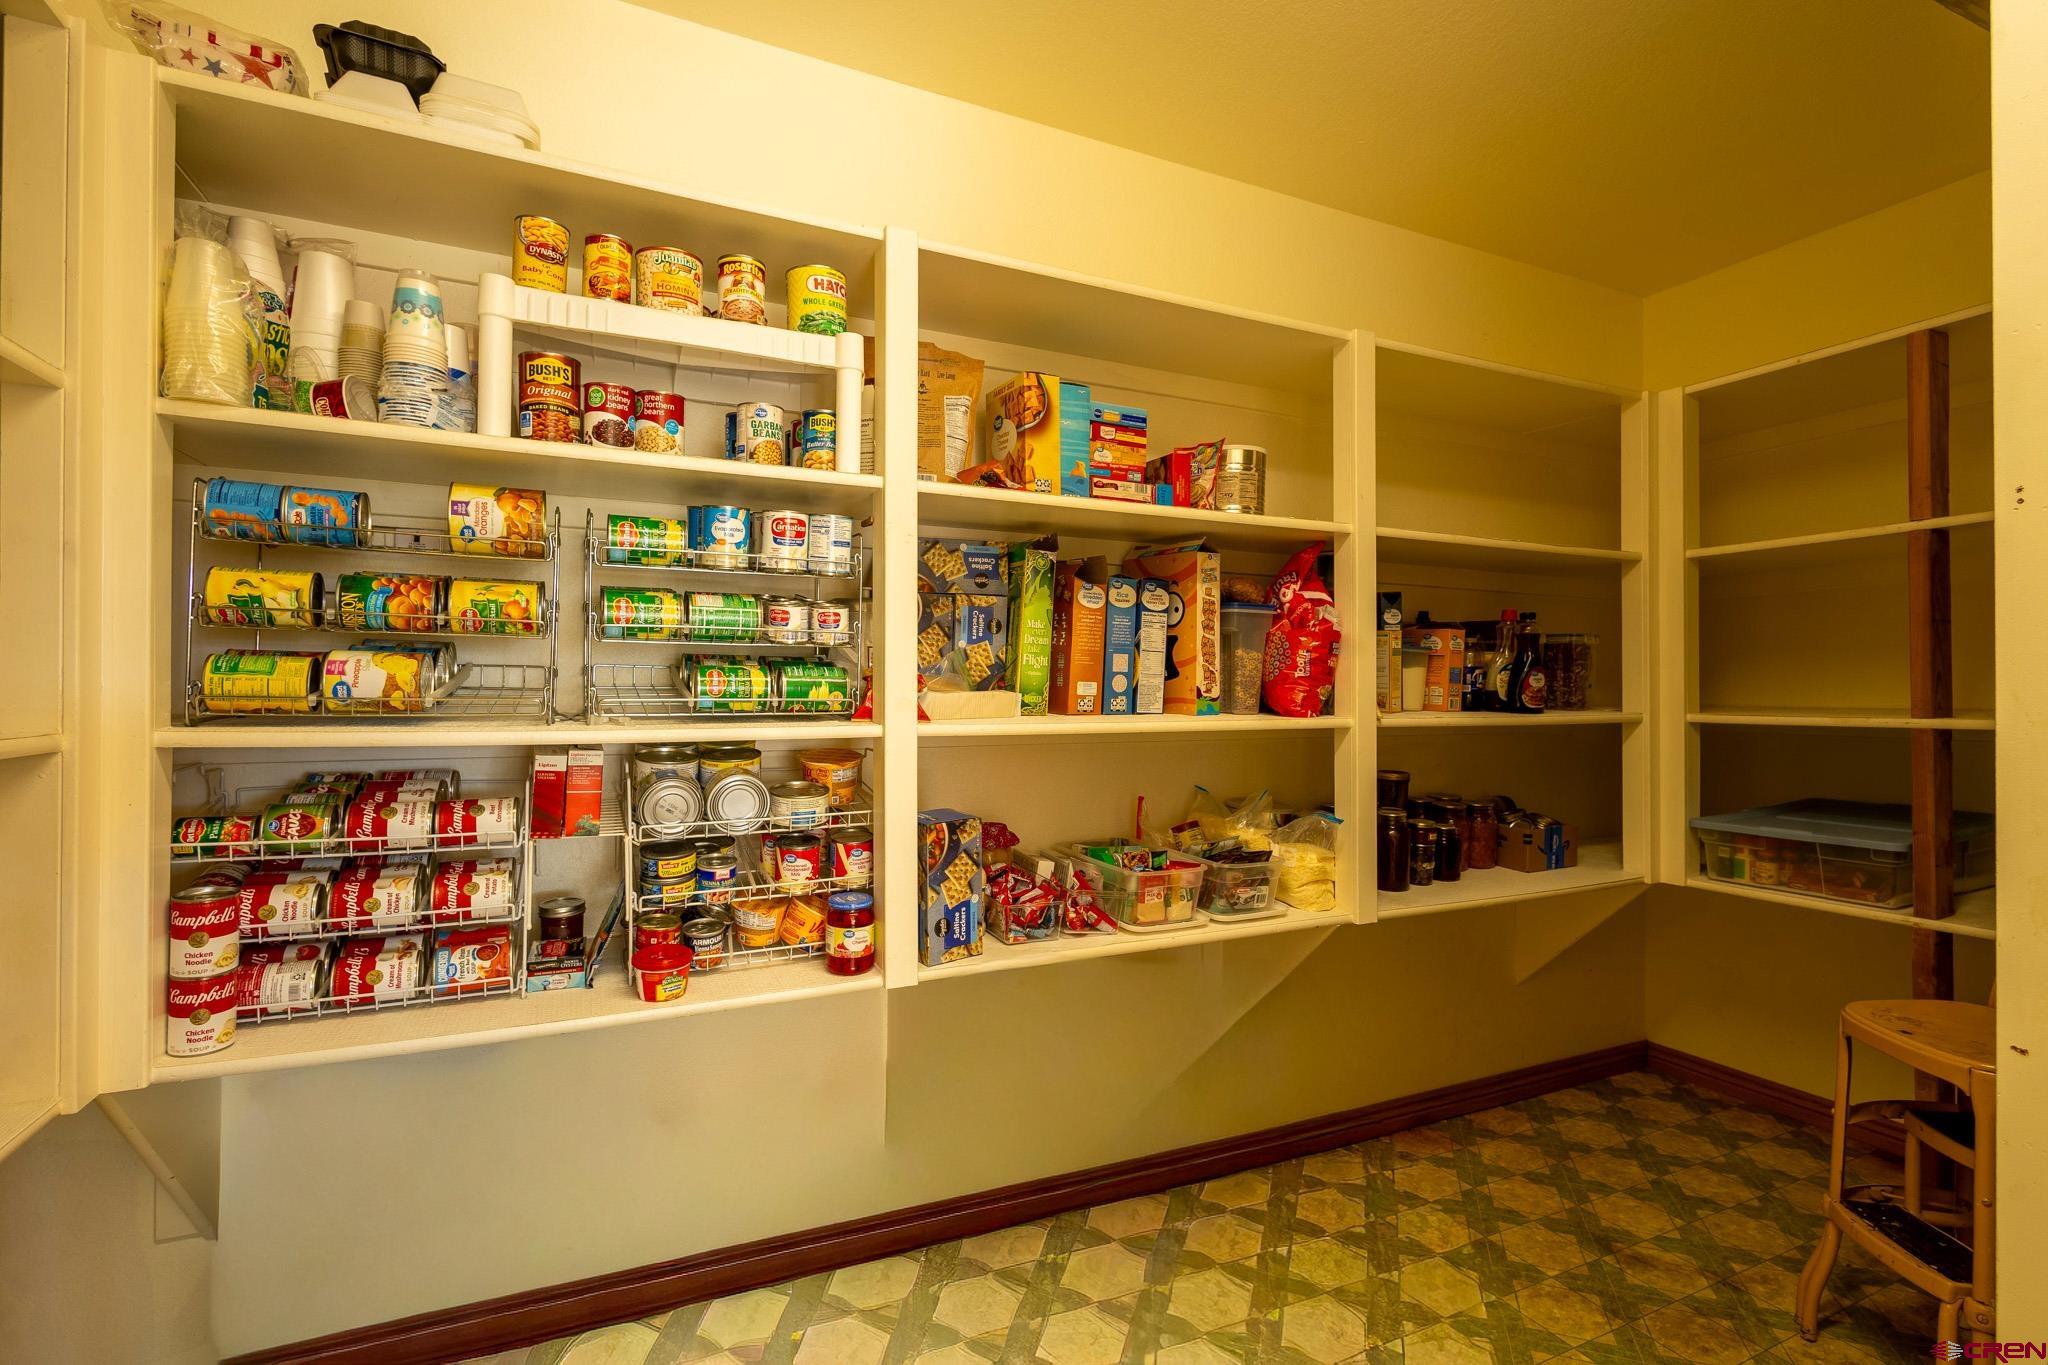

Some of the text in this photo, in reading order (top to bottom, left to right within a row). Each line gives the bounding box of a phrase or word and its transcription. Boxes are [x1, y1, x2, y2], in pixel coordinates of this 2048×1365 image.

[529, 245, 564, 262] DYNASTY
[653, 251, 697, 270] Juanita's
[522, 265, 564, 282] Baby Corn
[656, 283, 695, 297] HOMINY
[813, 277, 847, 298] HATC
[803, 298, 845, 311] WHOLE GREEN
[528, 363, 570, 382] BUSH'S
[527, 385, 572, 400] Original
[644, 395, 663, 403] great
[606, 401, 629, 411] beans
[607, 393, 631, 406] kidney
[644, 401, 675, 411] northern
[550, 406, 570, 415] BEANS
[644, 408, 665, 416] beans
[751, 420, 784, 431] GARBAN
[810, 417, 836, 428] BUSH'
[752, 429, 782, 440] BEANS
[480, 502, 490, 536] Oranges
[772, 521, 805, 533] Carnation
[356, 600, 366, 625] PRDE
[1026, 620, 1045, 629] Make
[1024, 635, 1049, 644] Dream
[1028, 645, 1040, 653] take
[1023, 653, 1048, 669] Flight
[352, 658, 362, 688] Pineapple
[408, 802, 417, 826] Mushroom
[209, 820, 221, 839] Paste
[280, 817, 288, 835] TOMATO
[288, 808, 302, 841] SAUCE
[490, 878, 498, 895] Potato
[387, 892, 393, 900] of
[393, 892, 401, 914] Chicken
[282, 900, 290, 922] Chicken
[290, 900, 298, 920] Noodle
[171, 906, 235, 929] Campbell's
[692, 935, 722, 946] ARMOUR
[695, 944, 710, 952] Vienna
[184, 951, 214, 959] Chicken
[185, 958, 212, 966] Noodle
[389, 964, 396, 973] of
[438, 950, 449, 982] CONDENSED
[187, 968, 209, 976] SOUP
[395, 961, 403, 989] Mushroom
[458, 960, 466, 979] French
[170, 980, 235, 1007] Campbell's
[185, 1028, 215, 1037] Chicken
[186, 1034, 214, 1044] Noodle
[188, 1045, 210, 1053] SOUP
